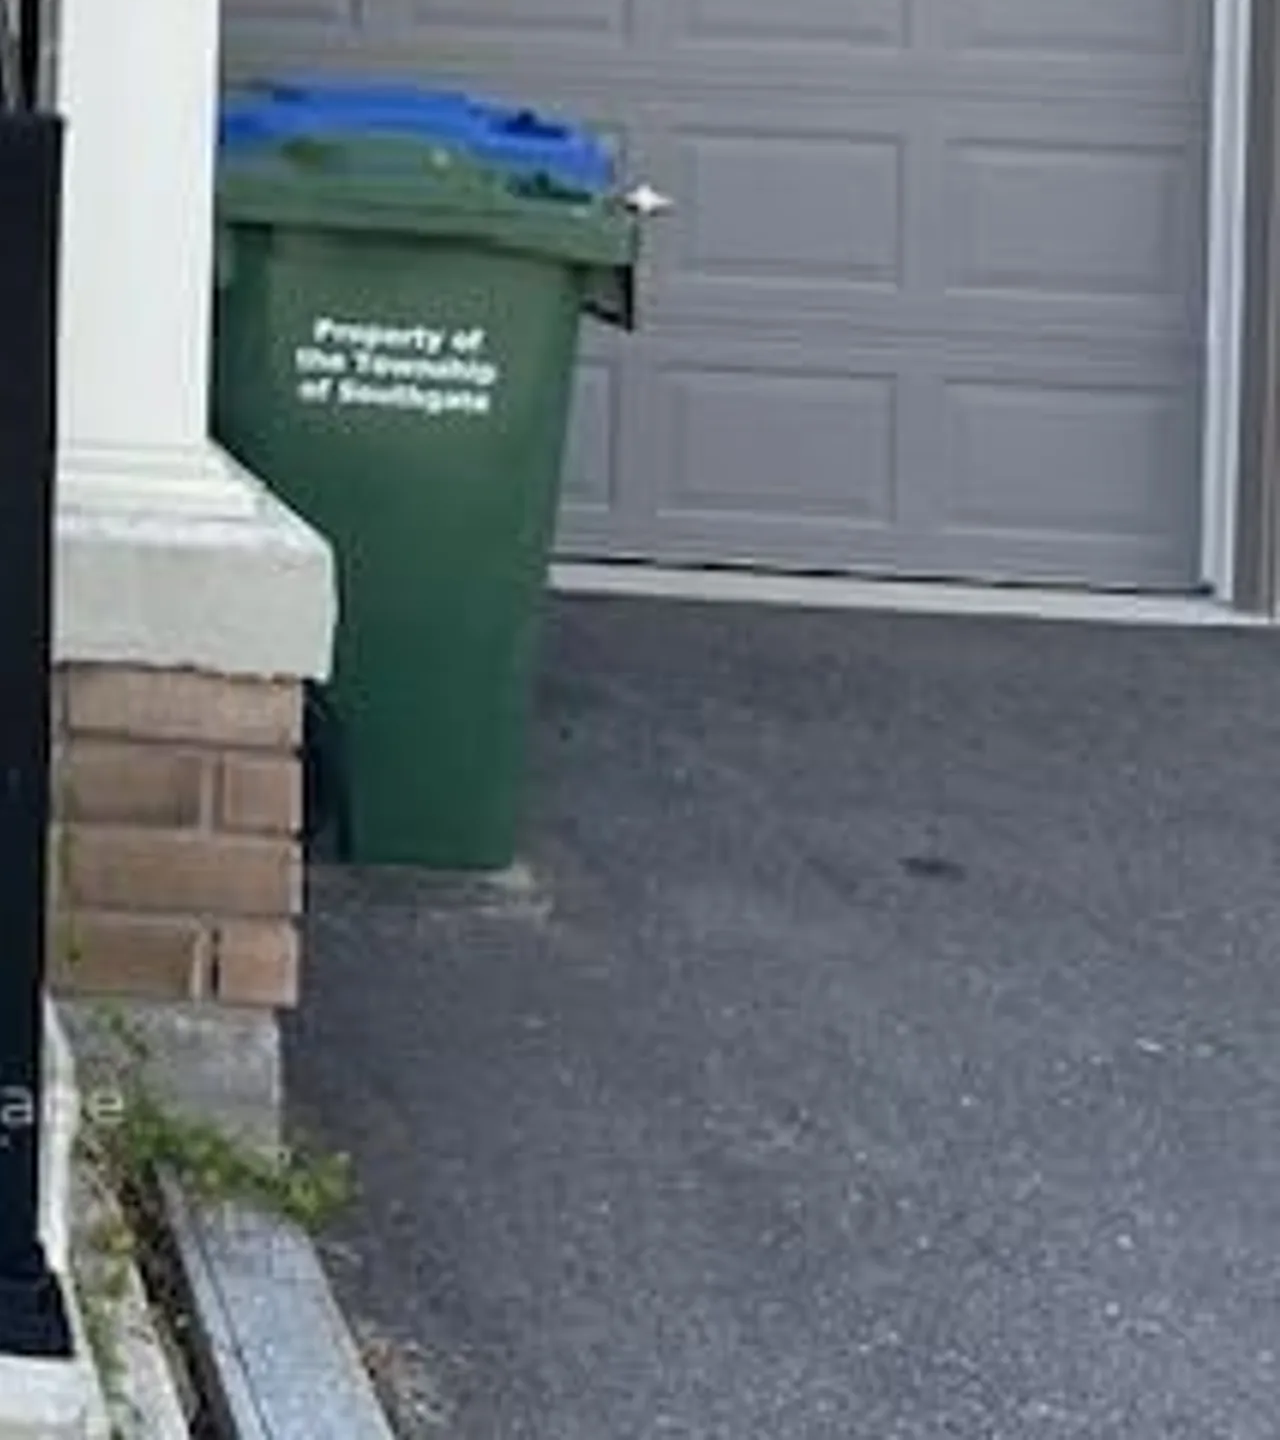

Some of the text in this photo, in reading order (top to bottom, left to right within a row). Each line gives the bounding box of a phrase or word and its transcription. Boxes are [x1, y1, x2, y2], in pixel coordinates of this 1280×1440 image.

[313, 317, 485, 354] Property of
[295, 347, 496, 385] the Township
[297, 377, 490, 413] of Southgate
